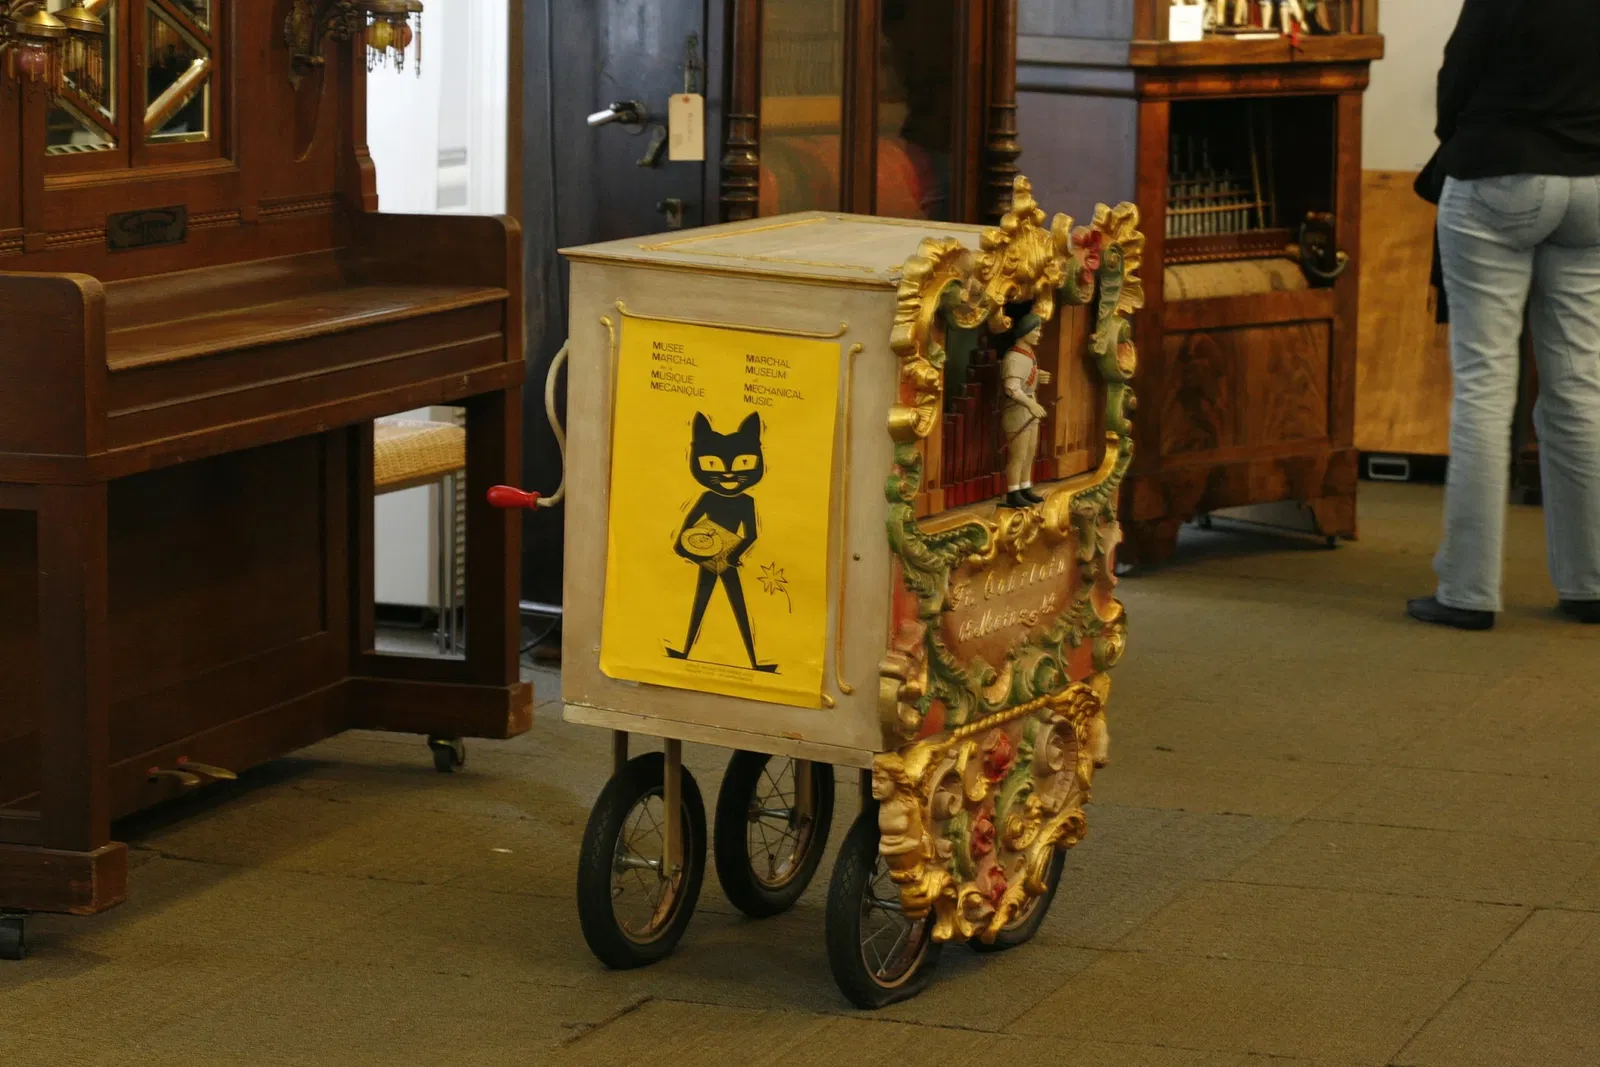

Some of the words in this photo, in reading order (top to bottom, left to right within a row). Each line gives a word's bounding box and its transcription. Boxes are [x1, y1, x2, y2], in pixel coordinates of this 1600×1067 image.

[652, 340, 685, 354] MUSEE
[651, 352, 698, 367] MARCHAL
[745, 354, 791, 369] MARCHAL
[650, 370, 694, 385] MUSIQUE
[744, 366, 787, 380] MUSEUM
[650, 381, 705, 398] MECANIQUE
[743, 383, 805, 401] MECHANICAL
[743, 395, 774, 408] MUSIC
